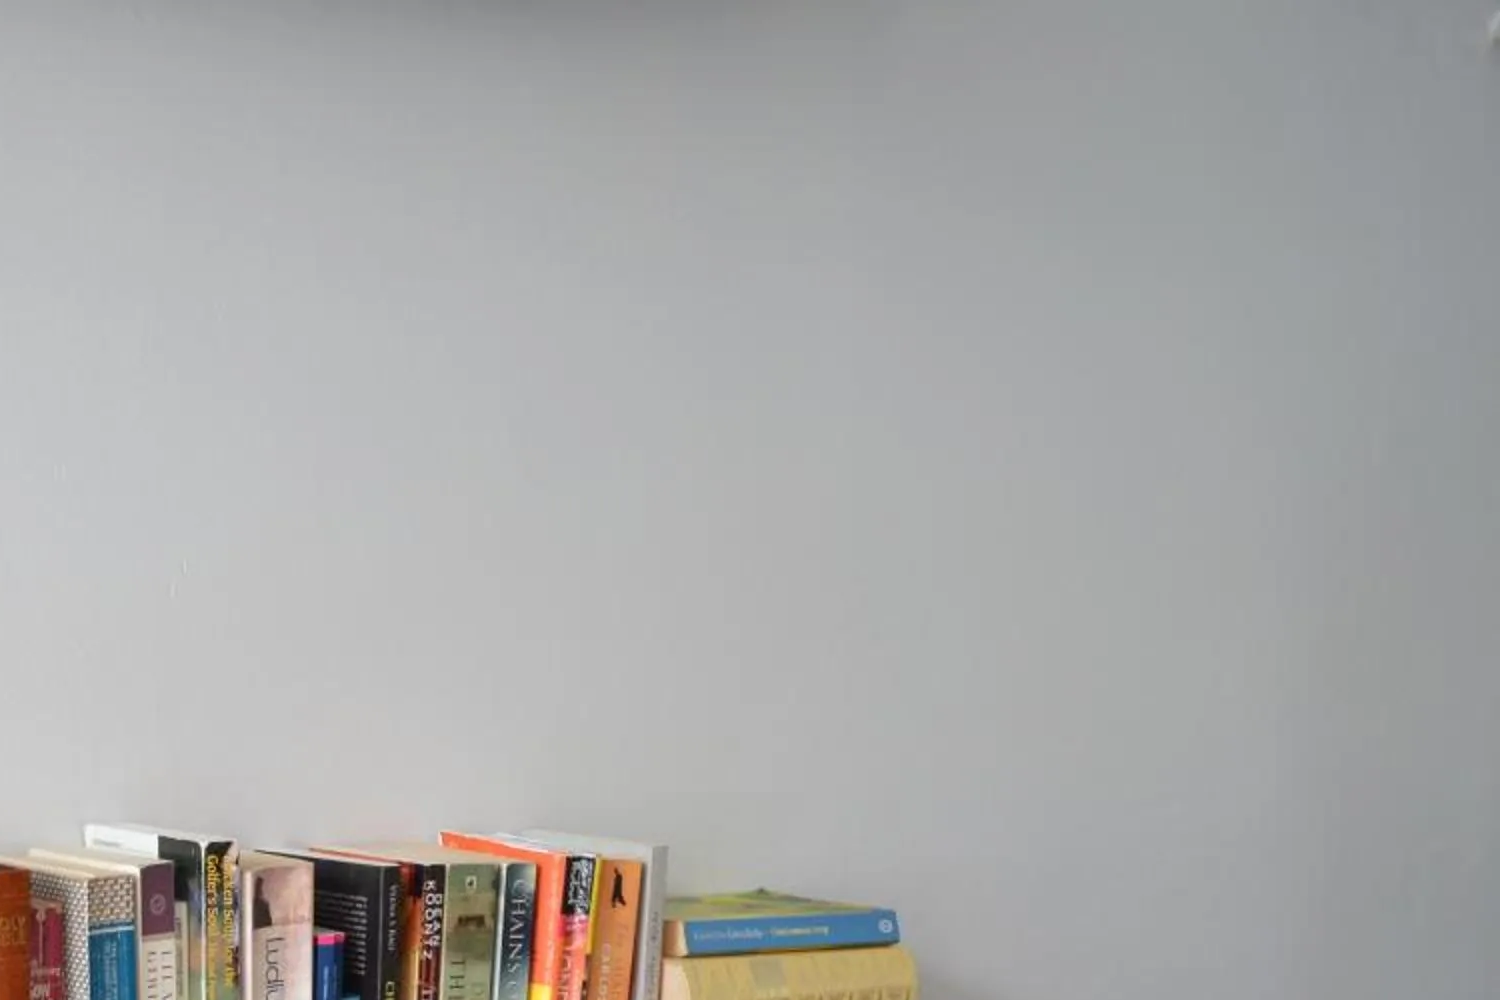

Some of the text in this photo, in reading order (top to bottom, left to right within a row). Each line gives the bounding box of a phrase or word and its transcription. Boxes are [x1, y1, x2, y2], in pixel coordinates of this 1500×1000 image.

[423, 879, 437, 960] KOONTZ
[431, 892, 443, 947] DEAN
[507, 878, 530, 978] CHAINS
